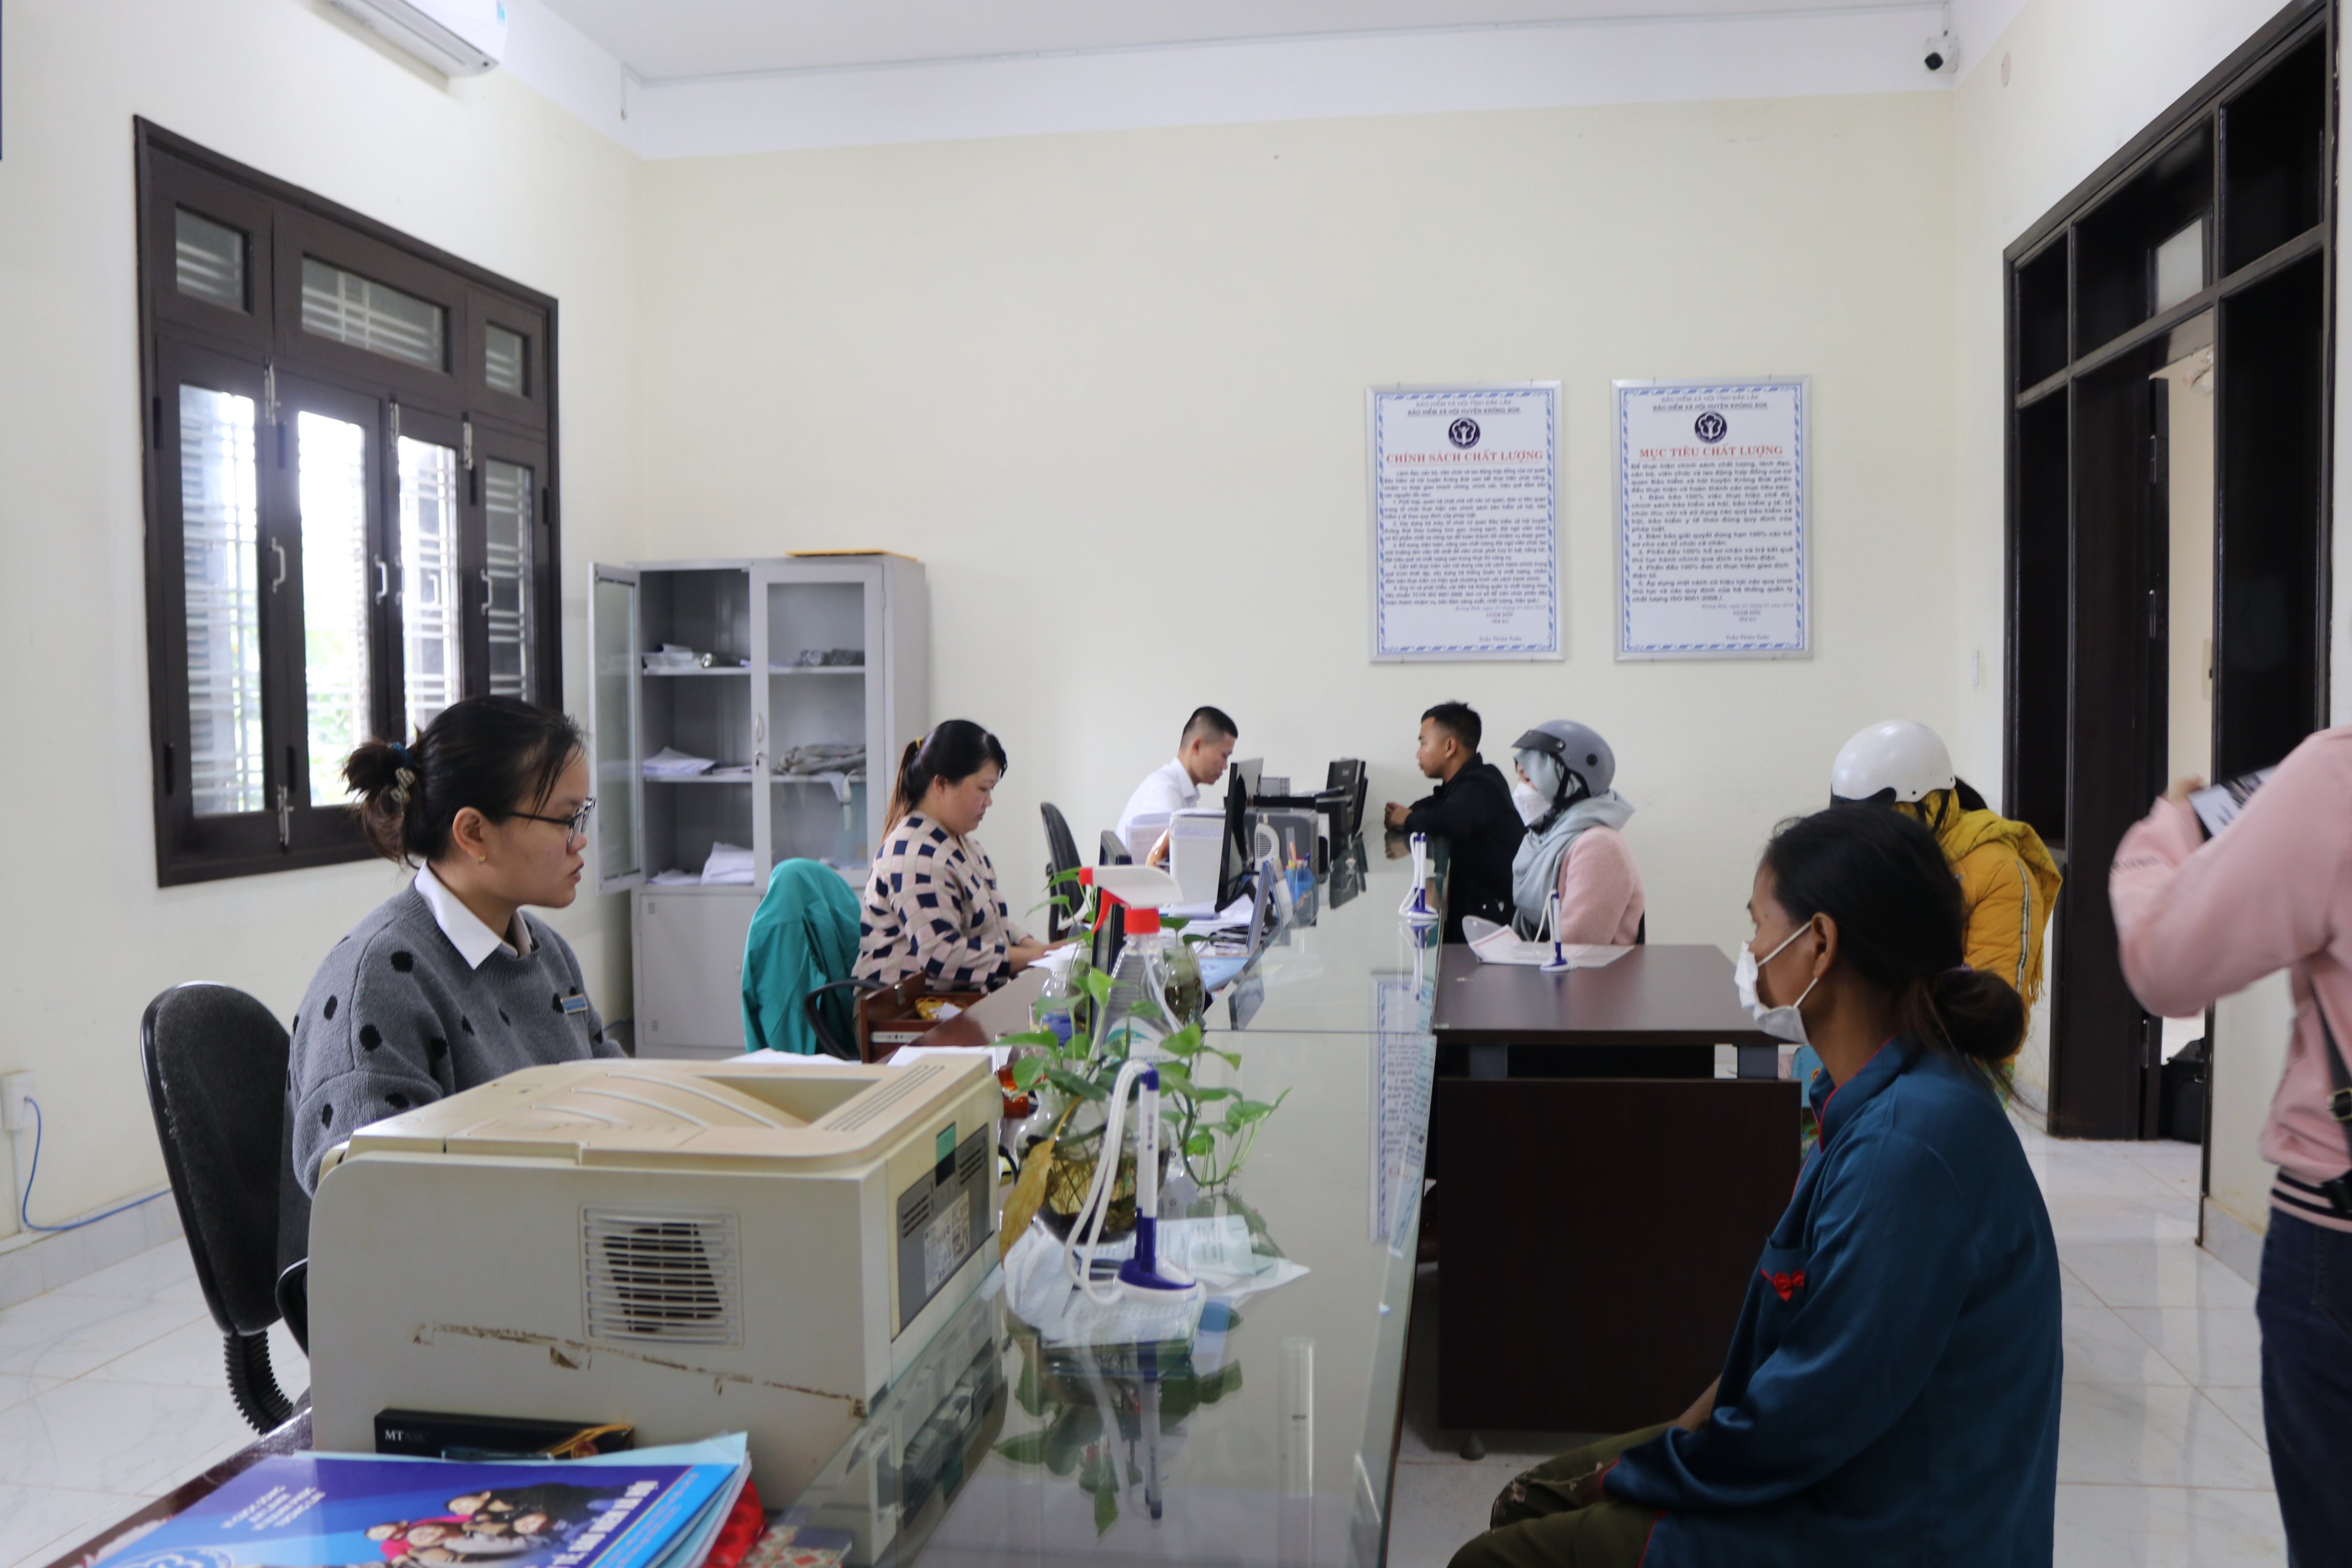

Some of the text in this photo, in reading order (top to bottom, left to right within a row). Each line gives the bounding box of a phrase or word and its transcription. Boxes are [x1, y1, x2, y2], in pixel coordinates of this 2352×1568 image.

[1387, 447, 1543, 463] CHÍNH SÁCH CHẤT LƯỢNG
[1639, 442, 1782, 459] MỤC TIÊU CHẤT LƯỢNG
